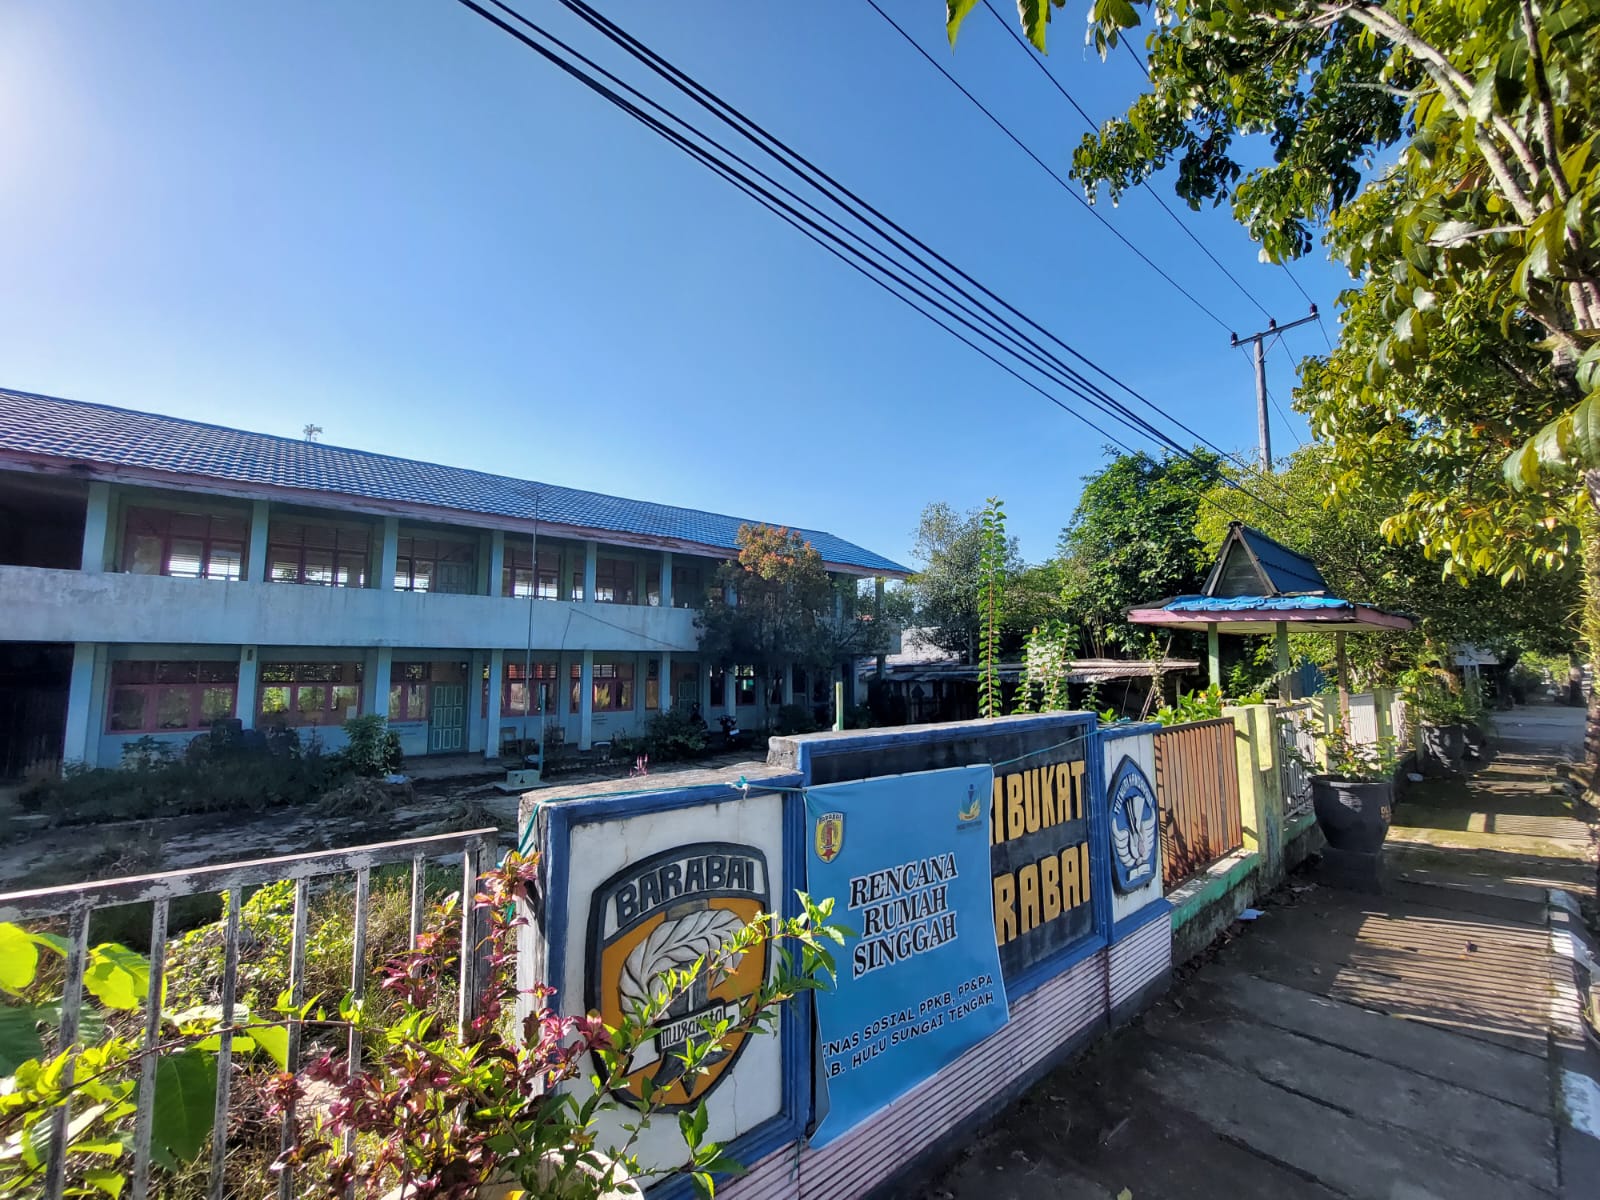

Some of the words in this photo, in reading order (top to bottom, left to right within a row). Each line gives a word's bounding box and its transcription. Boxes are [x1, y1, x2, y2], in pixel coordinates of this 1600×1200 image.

[990, 760, 1085, 845] IBUKAT
[616, 855, 754, 928] BARABAI
[849, 852, 958, 910] RENCANA
[862, 884, 948, 939] RUMAH
[853, 911, 957, 980] SINGGAH
[851, 1038, 887, 1069] HULU
[891, 1014, 945, 1045] SUNGAI
[948, 991, 994, 1022] TENGAH
[864, 1008, 915, 1040] SOSIAL
[919, 991, 955, 1016] PPKB,
[957, 974, 993, 997] PP&PA
